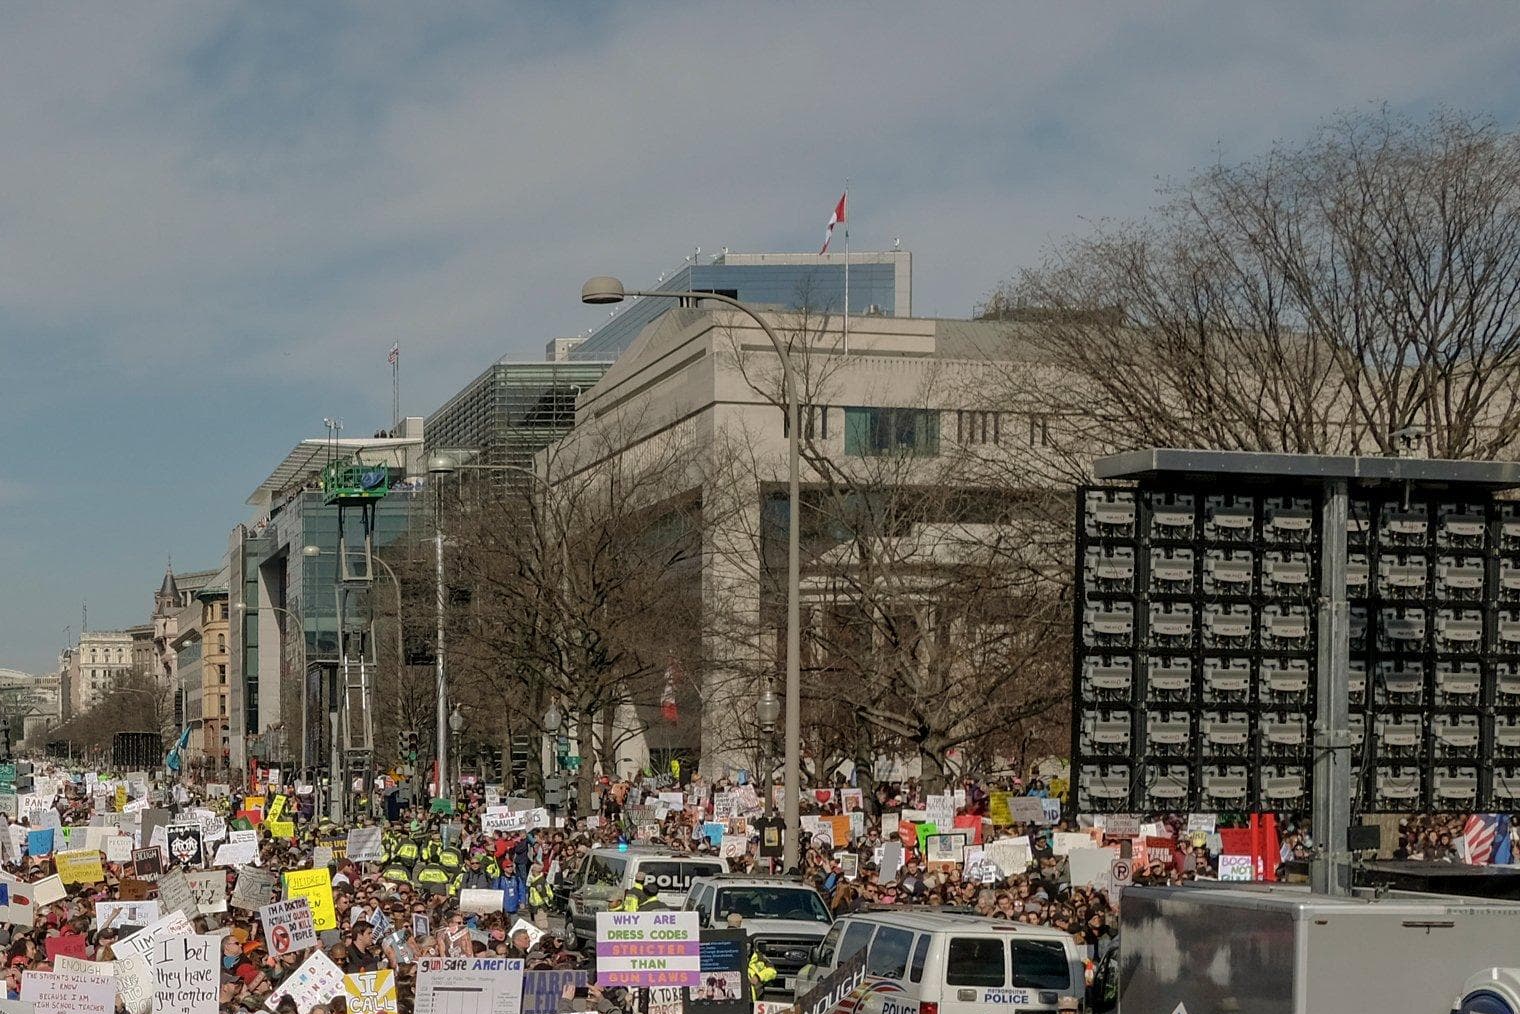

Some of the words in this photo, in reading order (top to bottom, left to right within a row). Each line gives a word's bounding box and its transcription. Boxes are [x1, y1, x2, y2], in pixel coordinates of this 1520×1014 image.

[498, 811, 516, 819] BAN
[486, 818, 515, 828] ASSAULT
[610, 944, 686, 956] STRICTER
[61, 958, 101, 974] ENOUGH
[420, 959, 444, 972] gun
[444, 960, 467, 971] safe
[472, 958, 521, 971] America
[631, 958, 666, 969] THAN
[157, 967, 181, 989] they
[184, 967, 212, 981] have
[608, 972, 639, 984] GUN
[647, 972, 688, 984] LAWS
[154, 990, 176, 1011] gun
[177, 987, 218, 1003] control
[348, 996, 395, 1013] CALL
[984, 993, 1029, 1004] POLICE
